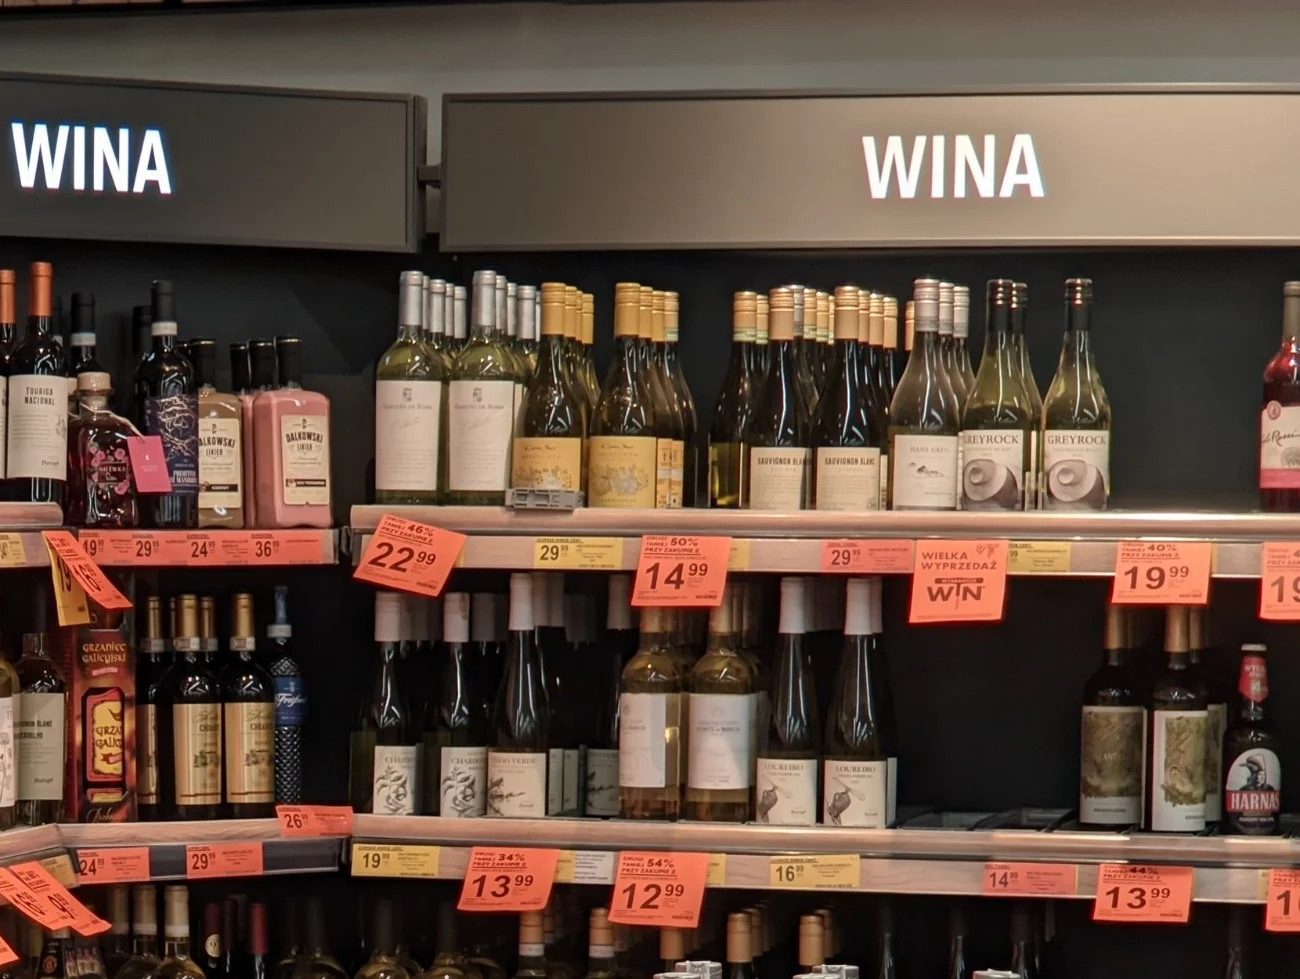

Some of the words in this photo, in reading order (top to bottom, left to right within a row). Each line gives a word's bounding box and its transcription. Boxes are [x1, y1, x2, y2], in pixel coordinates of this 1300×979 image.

[11, 122, 172, 195] WINA
[862, 133, 1045, 199] WINA
[26, 386, 53, 396] TOURIGA
[24, 397, 55, 406] NACIONAL
[200, 439, 236, 449] ALKOWSKI
[1048, 435, 1107, 445] GREYROCK
[407, 523, 434, 537] 46%
[670, 538, 698, 546] 50%
[922, 552, 968, 560] WIELKA
[921, 560, 997, 571] WYPRZEDAŻ
[836, 765, 876, 774] LOUREIRO
[497, 853, 525, 862] 34%
[647, 859, 674, 868] 54%
